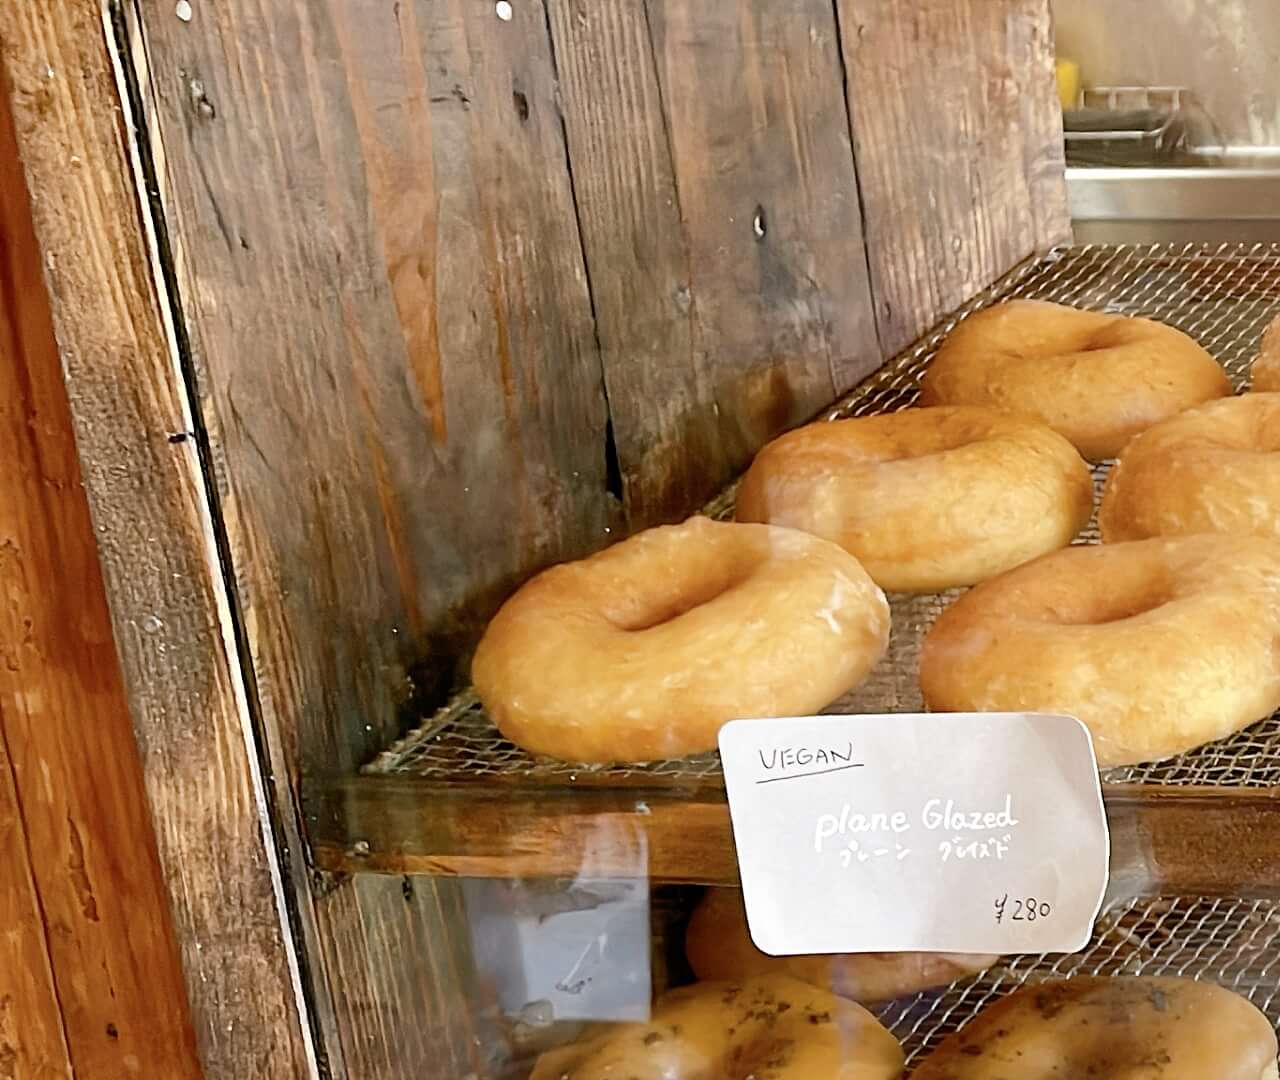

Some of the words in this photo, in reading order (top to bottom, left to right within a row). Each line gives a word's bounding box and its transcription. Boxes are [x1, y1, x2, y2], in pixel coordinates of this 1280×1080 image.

[759, 743, 852, 769] VEGAN
[922, 794, 1018, 829] Glazed
[938, 835, 1012, 861] グレイズド
[995, 894, 1050, 924] ¥280
